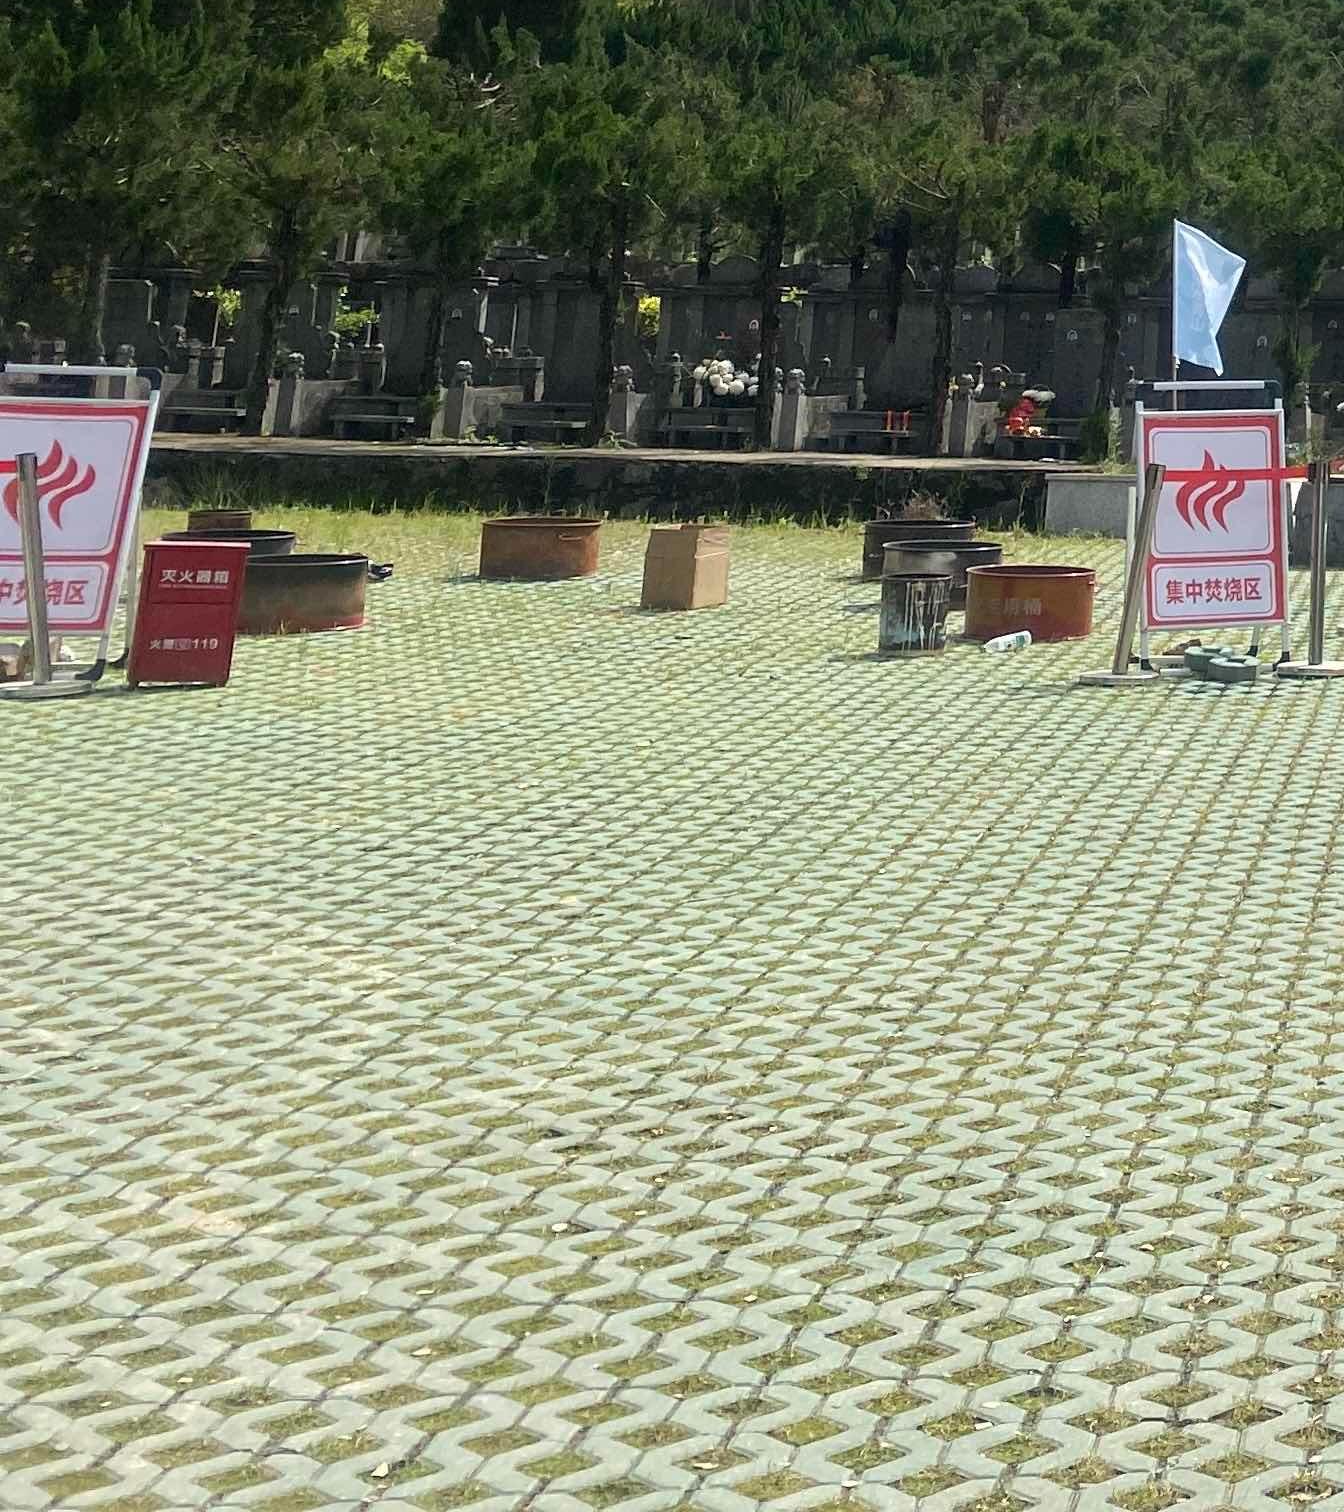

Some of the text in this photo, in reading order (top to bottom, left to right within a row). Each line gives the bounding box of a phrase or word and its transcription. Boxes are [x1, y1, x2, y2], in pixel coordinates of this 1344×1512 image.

[1166, 577, 1262, 605] 集中焚烧区
